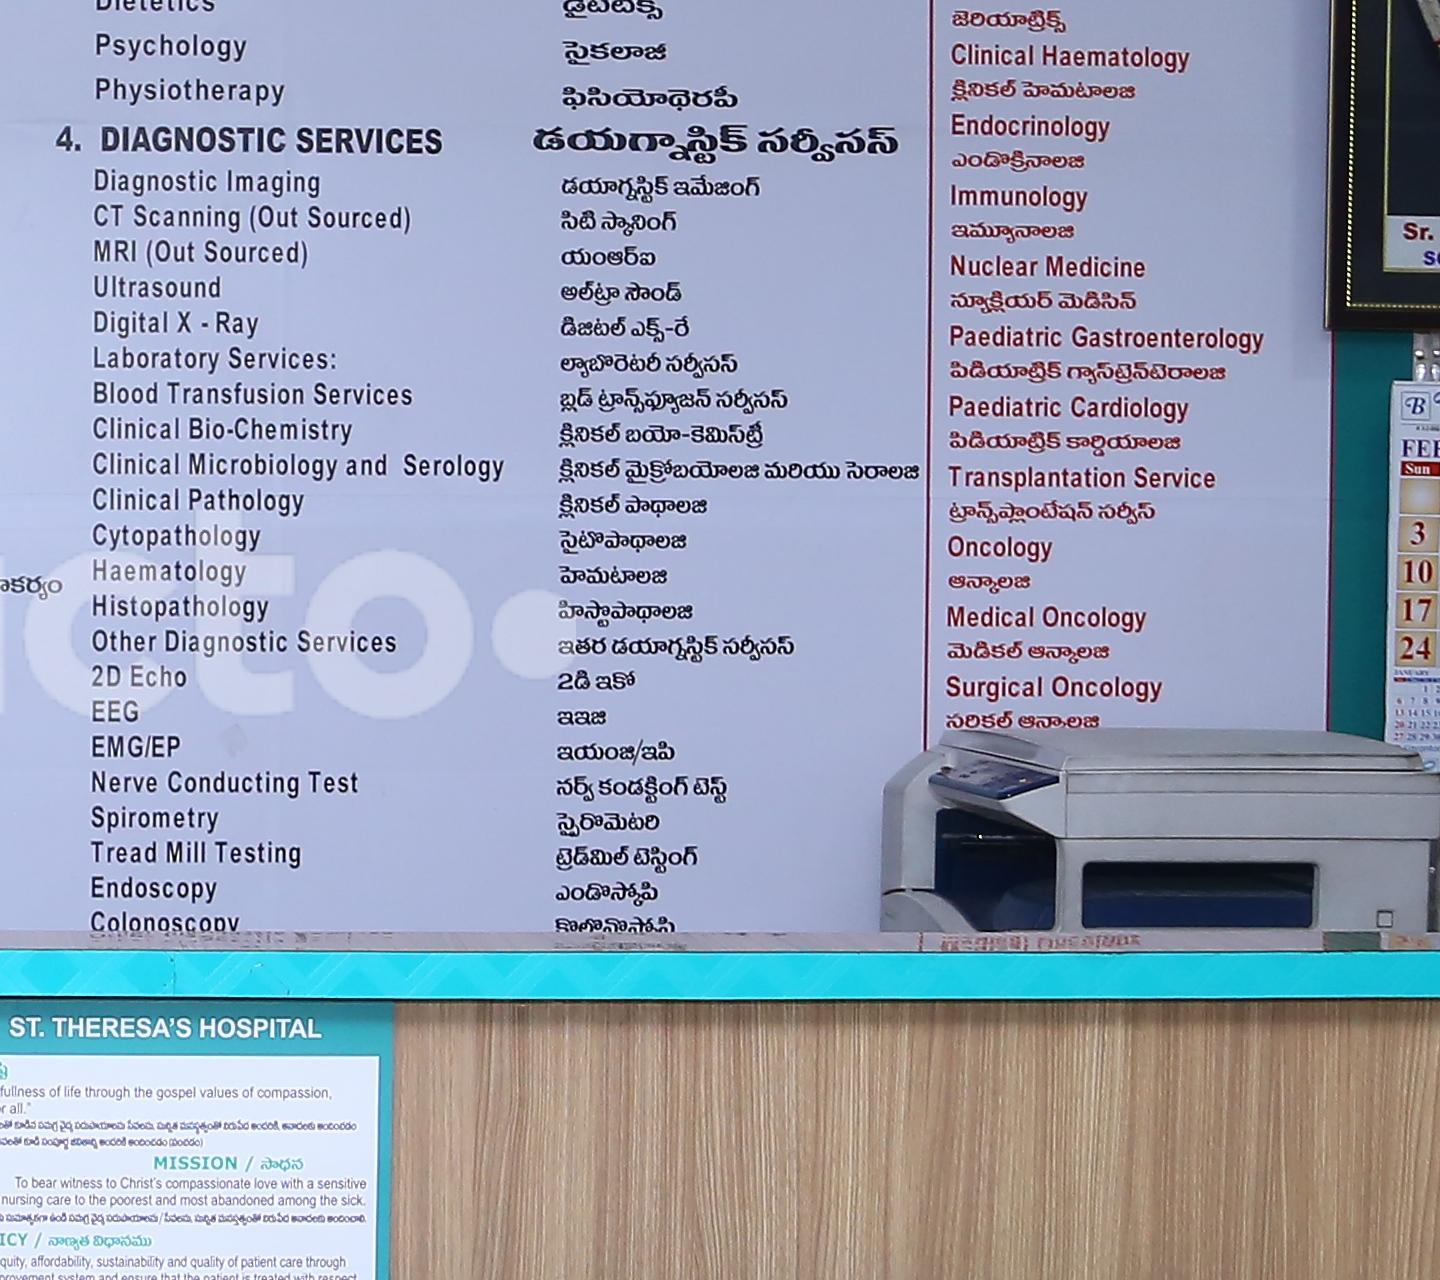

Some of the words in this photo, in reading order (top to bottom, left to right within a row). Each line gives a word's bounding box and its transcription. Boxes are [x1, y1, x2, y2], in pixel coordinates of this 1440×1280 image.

[56, 126, 81, 151] 4.
[102, 126, 286, 153] DIAGNOSTIC
[296, 127, 442, 154] SERVICES
[951, 184, 1088, 212] Immunology
[1403, 222, 1434, 241] Sr.
[94, 275, 220, 298] Ultrasound
[1405, 464, 1430, 474] Sun
[948, 536, 1052, 563] Oncology
[93, 559, 246, 587] Haematology
[946, 676, 1042, 702] Surgical
[1052, 676, 1162, 703] Oncology
[92, 701, 138, 722] EEG
[92, 736, 180, 758] EMG/EP
[92, 806, 218, 834] Spirometry
[91, 841, 156, 863] Tread
[167, 841, 205, 863] Mill
[215, 841, 300, 869] Testing
[9, 1014, 44, 1037] ST.
[198, 1015, 322, 1038] HOSPITAL
[0, 1085, 45, 1098] fullness
[49, 1086, 61, 1098] of
[64, 1086, 81, 1098] life
[85, 1086, 130, 1101] through
[134, 1086, 153, 1098] the
[156, 1087, 196, 1101] gospel
[200, 1087, 238, 1098] values
[242, 1086, 254, 1098] of
[257, 1089, 332, 1101] compassion,
[154, 1156, 237, 1170] MISSION
